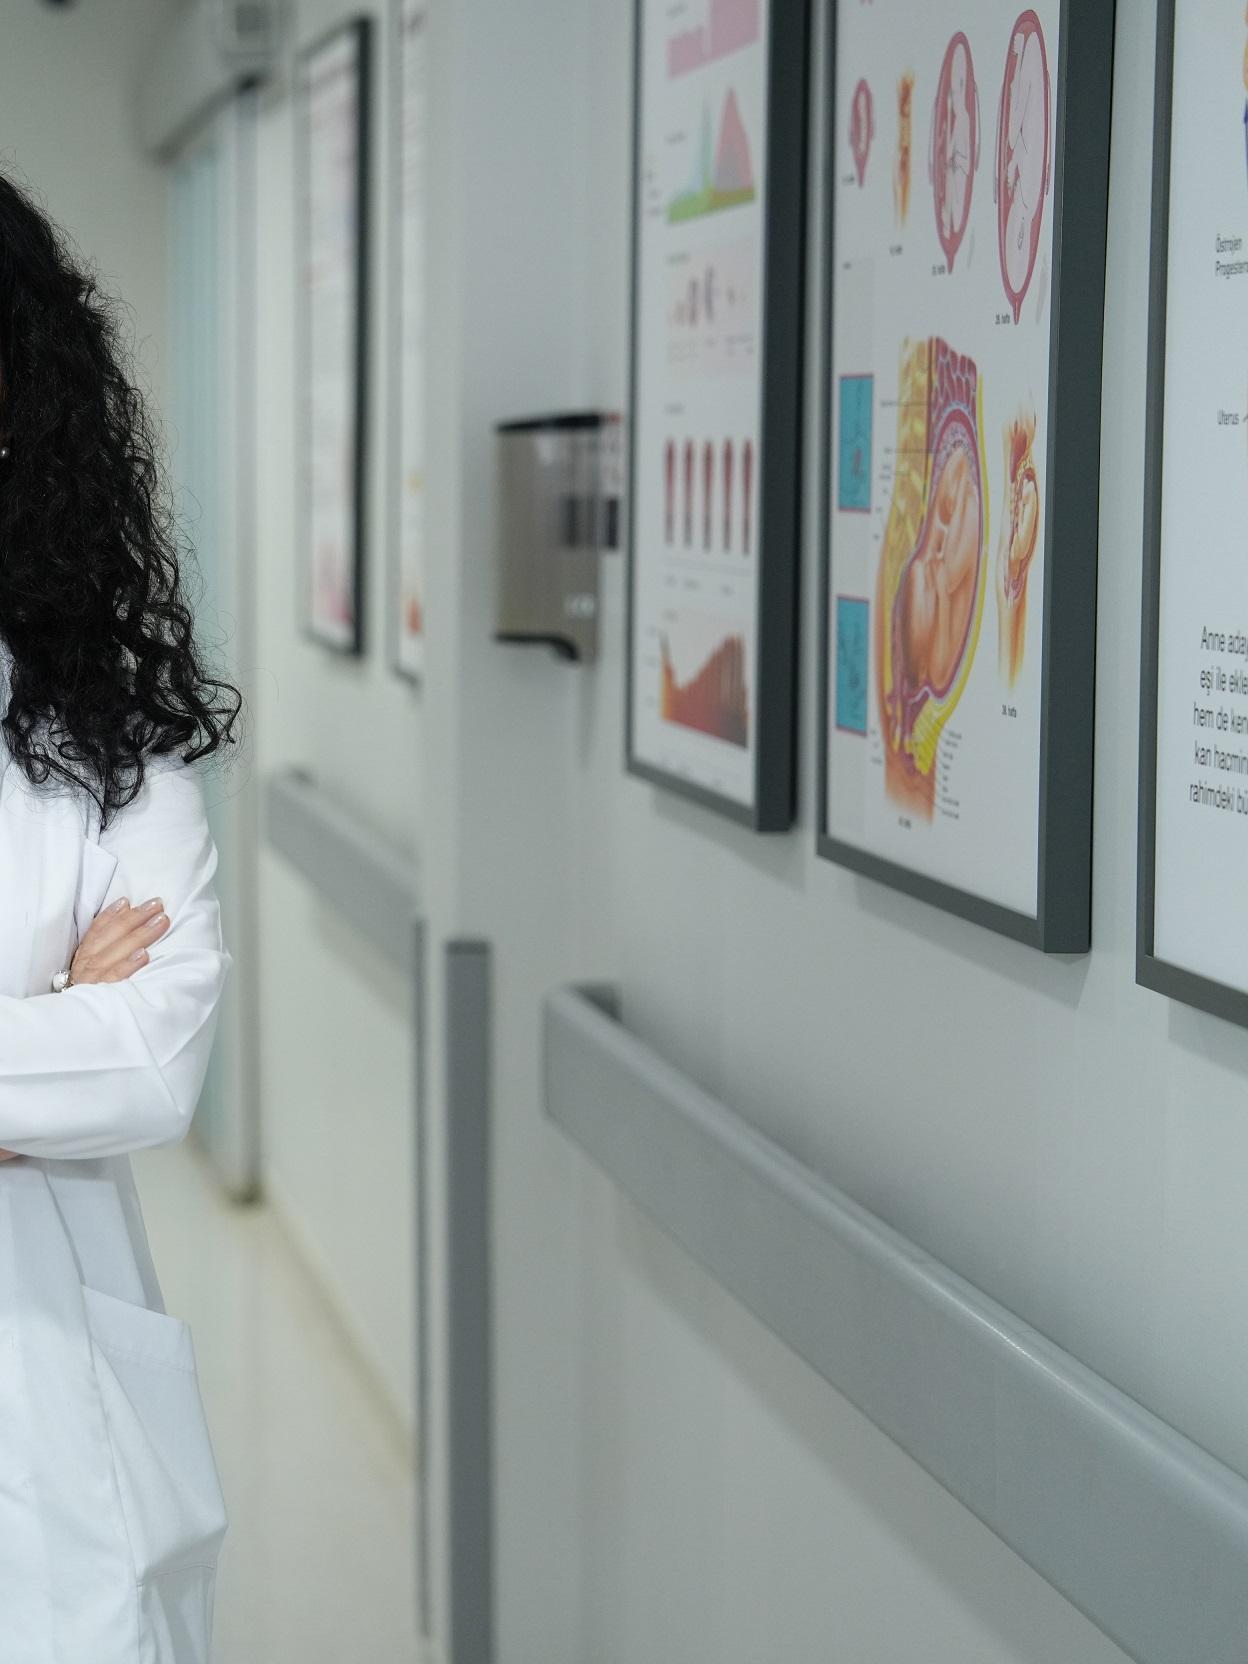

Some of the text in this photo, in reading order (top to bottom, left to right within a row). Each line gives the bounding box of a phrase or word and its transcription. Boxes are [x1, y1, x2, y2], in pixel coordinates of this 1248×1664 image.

[1217, 409, 1239, 425] Uterus
[1201, 625, 1225, 652] Anne
[1200, 665, 1214, 695] eşi
[1215, 666, 1226, 691] ile
[1193, 700, 1214, 728] hem
[1216, 706, 1229, 731] de
[1194, 739, 1211, 767] kan
[1189, 779, 1233, 812] rahimdeki
